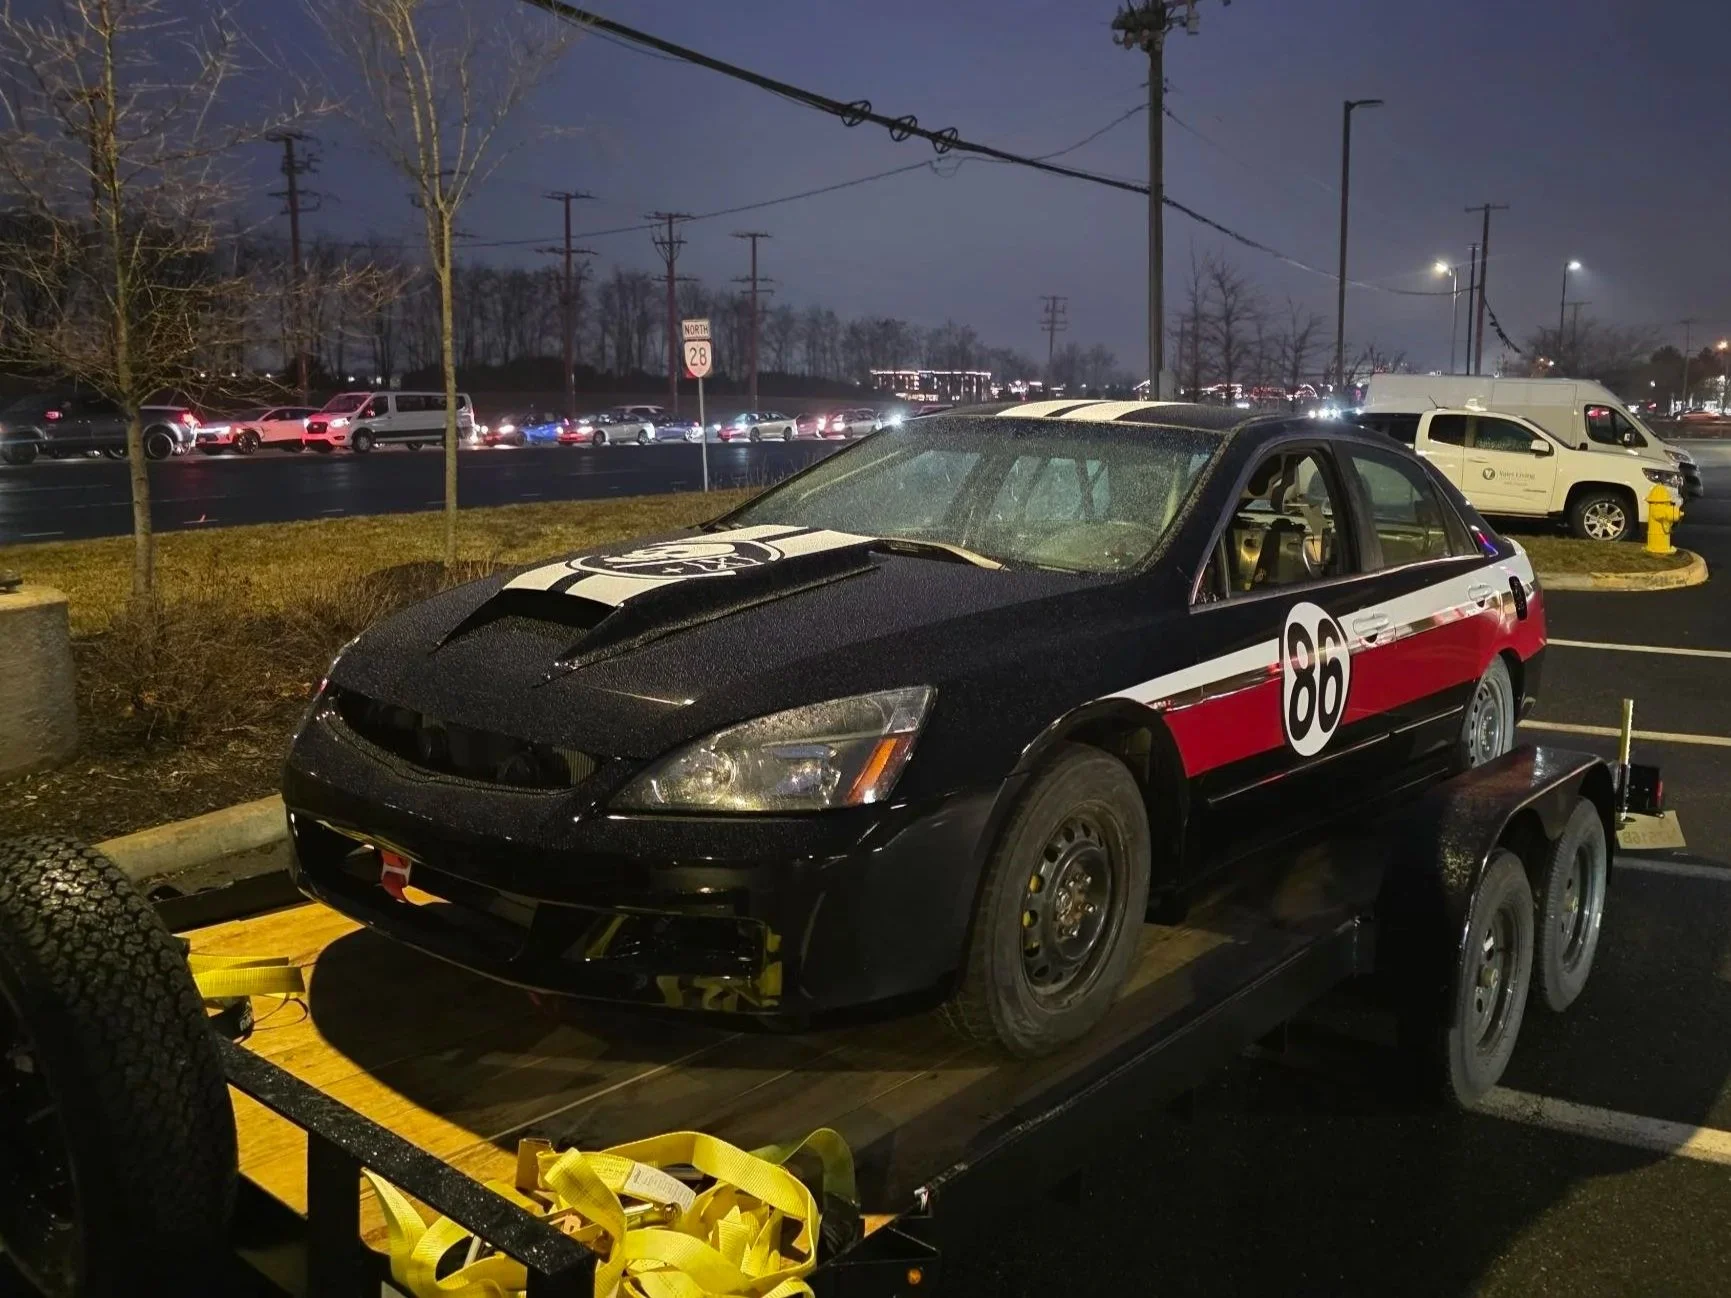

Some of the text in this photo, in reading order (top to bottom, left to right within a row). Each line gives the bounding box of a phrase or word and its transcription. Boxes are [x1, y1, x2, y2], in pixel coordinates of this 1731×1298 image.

[685, 324, 709, 335] NORTH
[689, 347, 707, 366] 28
[1287, 618, 1343, 741] 86
